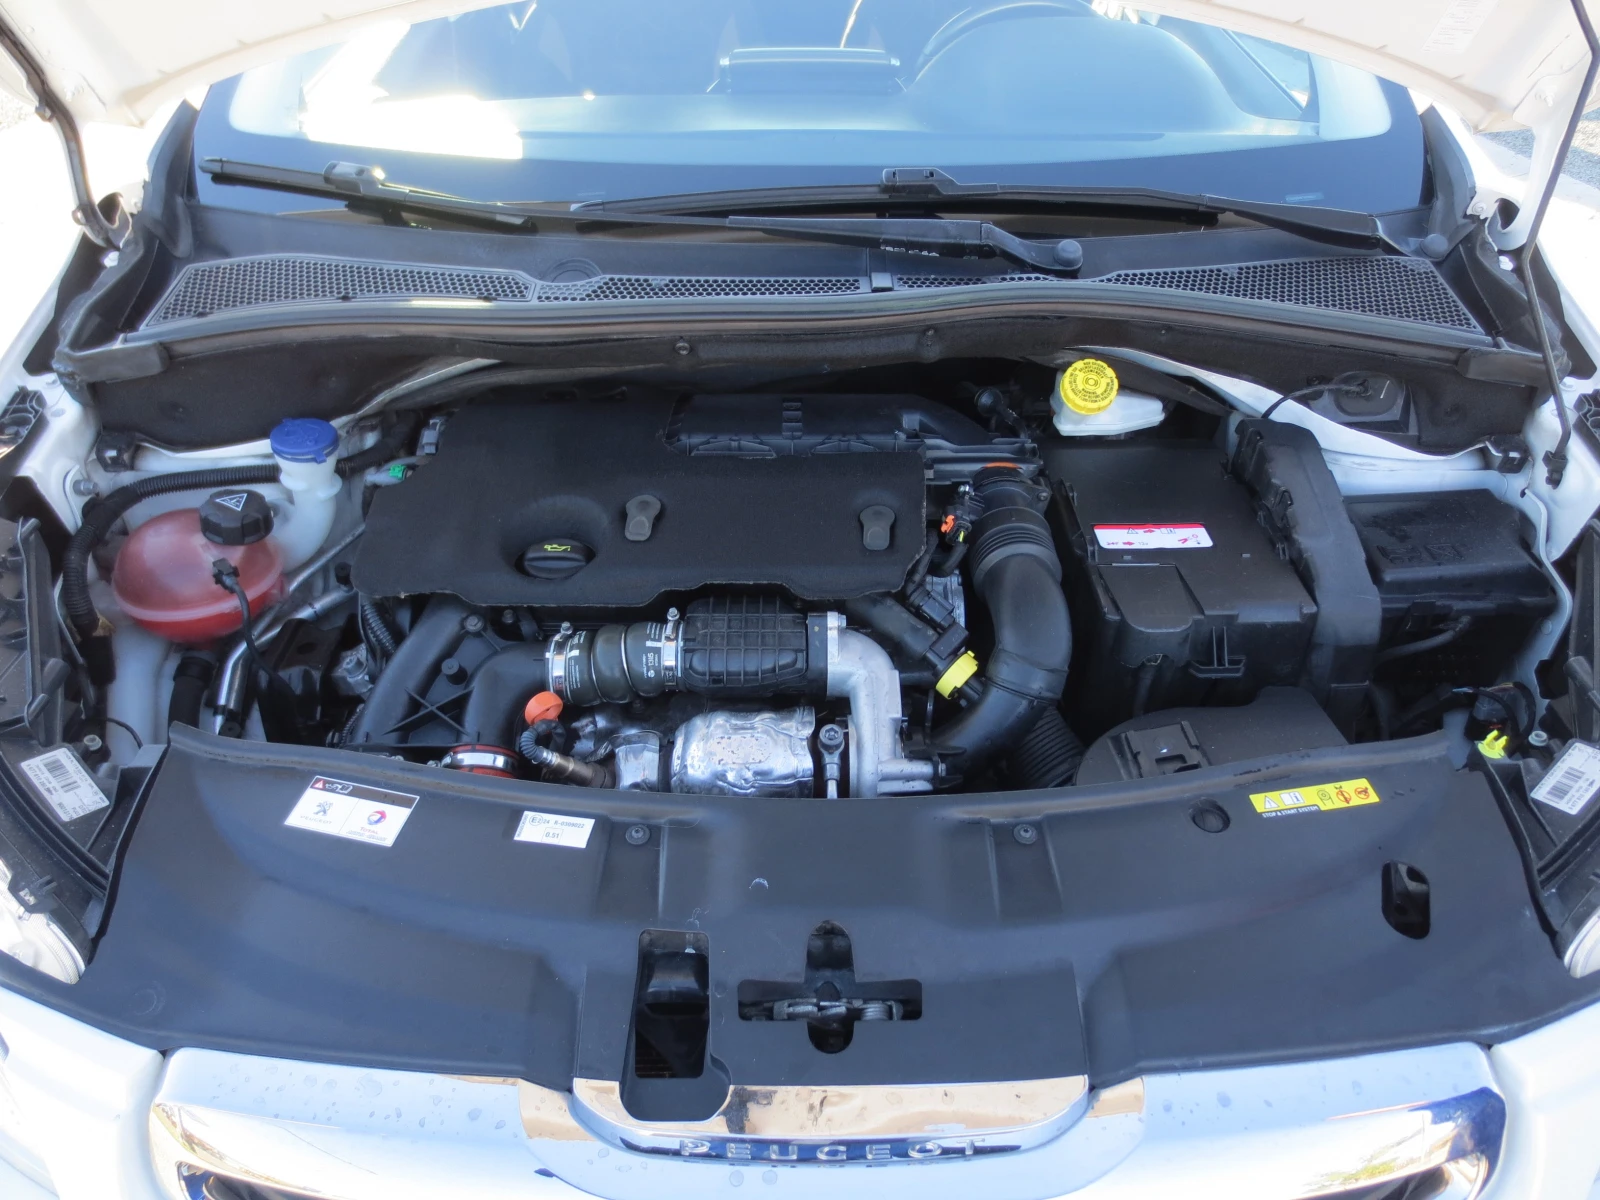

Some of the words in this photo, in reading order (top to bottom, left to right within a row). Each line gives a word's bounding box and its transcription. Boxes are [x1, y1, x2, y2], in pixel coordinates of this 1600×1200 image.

[300, 814, 333, 825] PEUGEOT
[360, 826, 379, 835] TOTAL
[545, 831, 560, 839] 0.51
[680, 1138, 986, 1160] PEUGEOT
